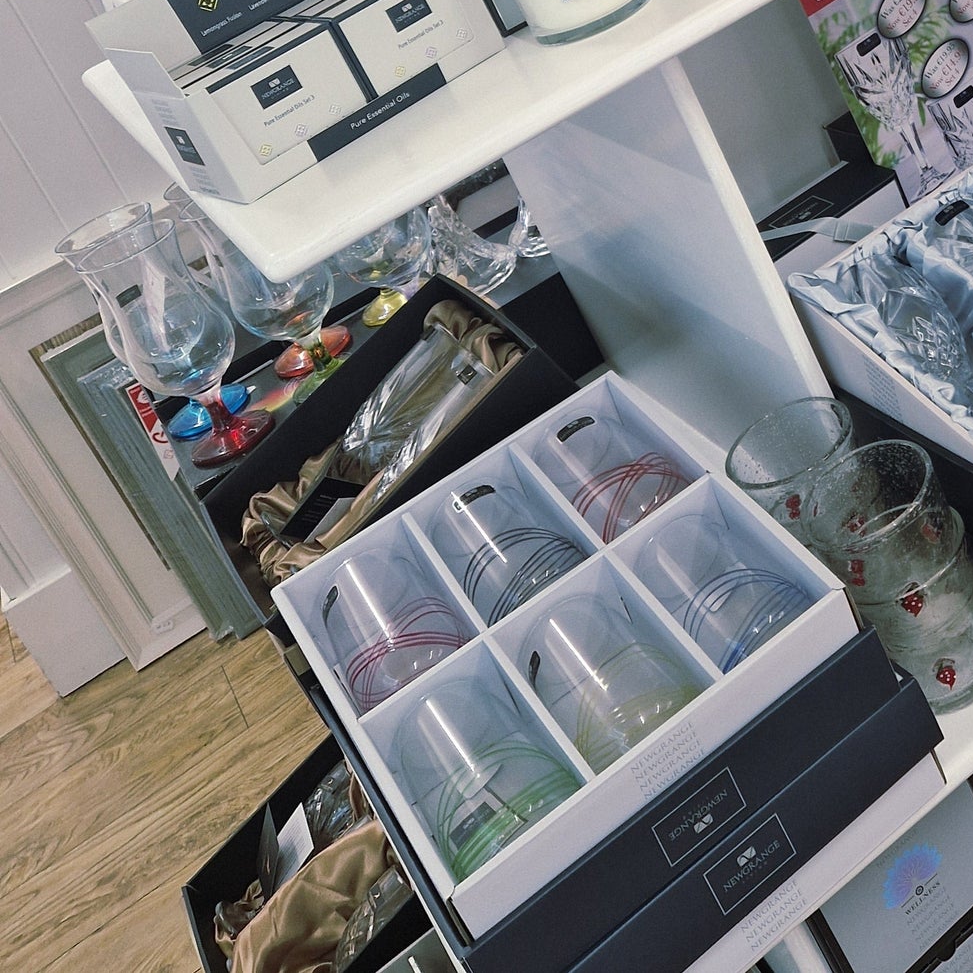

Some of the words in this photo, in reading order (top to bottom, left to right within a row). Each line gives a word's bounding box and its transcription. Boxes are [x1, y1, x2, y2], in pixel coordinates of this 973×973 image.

[881, 6, 895, 20] Was
[902, 15, 914, 28] Set
[957, 2, 971, 16] Now
[201, 18, 227, 37] Lemongrass
[226, 11, 243, 23] Fusion
[408, 29, 426, 44] Essential
[888, 17, 902, 31] Now
[925, 65, 938, 80] Was
[930, 77, 944, 91] Now
[944, 74, 956, 87] Set
[264, 116, 275, 128] Pure
[274, 105, 294, 122] Essential
[293, 101, 304, 111] Oils
[350, 116, 367, 130] Pure
[366, 100, 396, 122] Essential
[396, 92, 410, 106] Oils
[630, 720, 695, 774] NEWGRANGE
[635, 730, 699, 782] NEWGRANGE
[669, 788, 729, 841] NEWGRANGE
[723, 840, 780, 892] NEWGRANGE
[905, 881, 941, 916] WELLNESS
[746, 889, 803, 942] NEWGRANGE
[751, 898, 809, 951] NEWGRANGE
